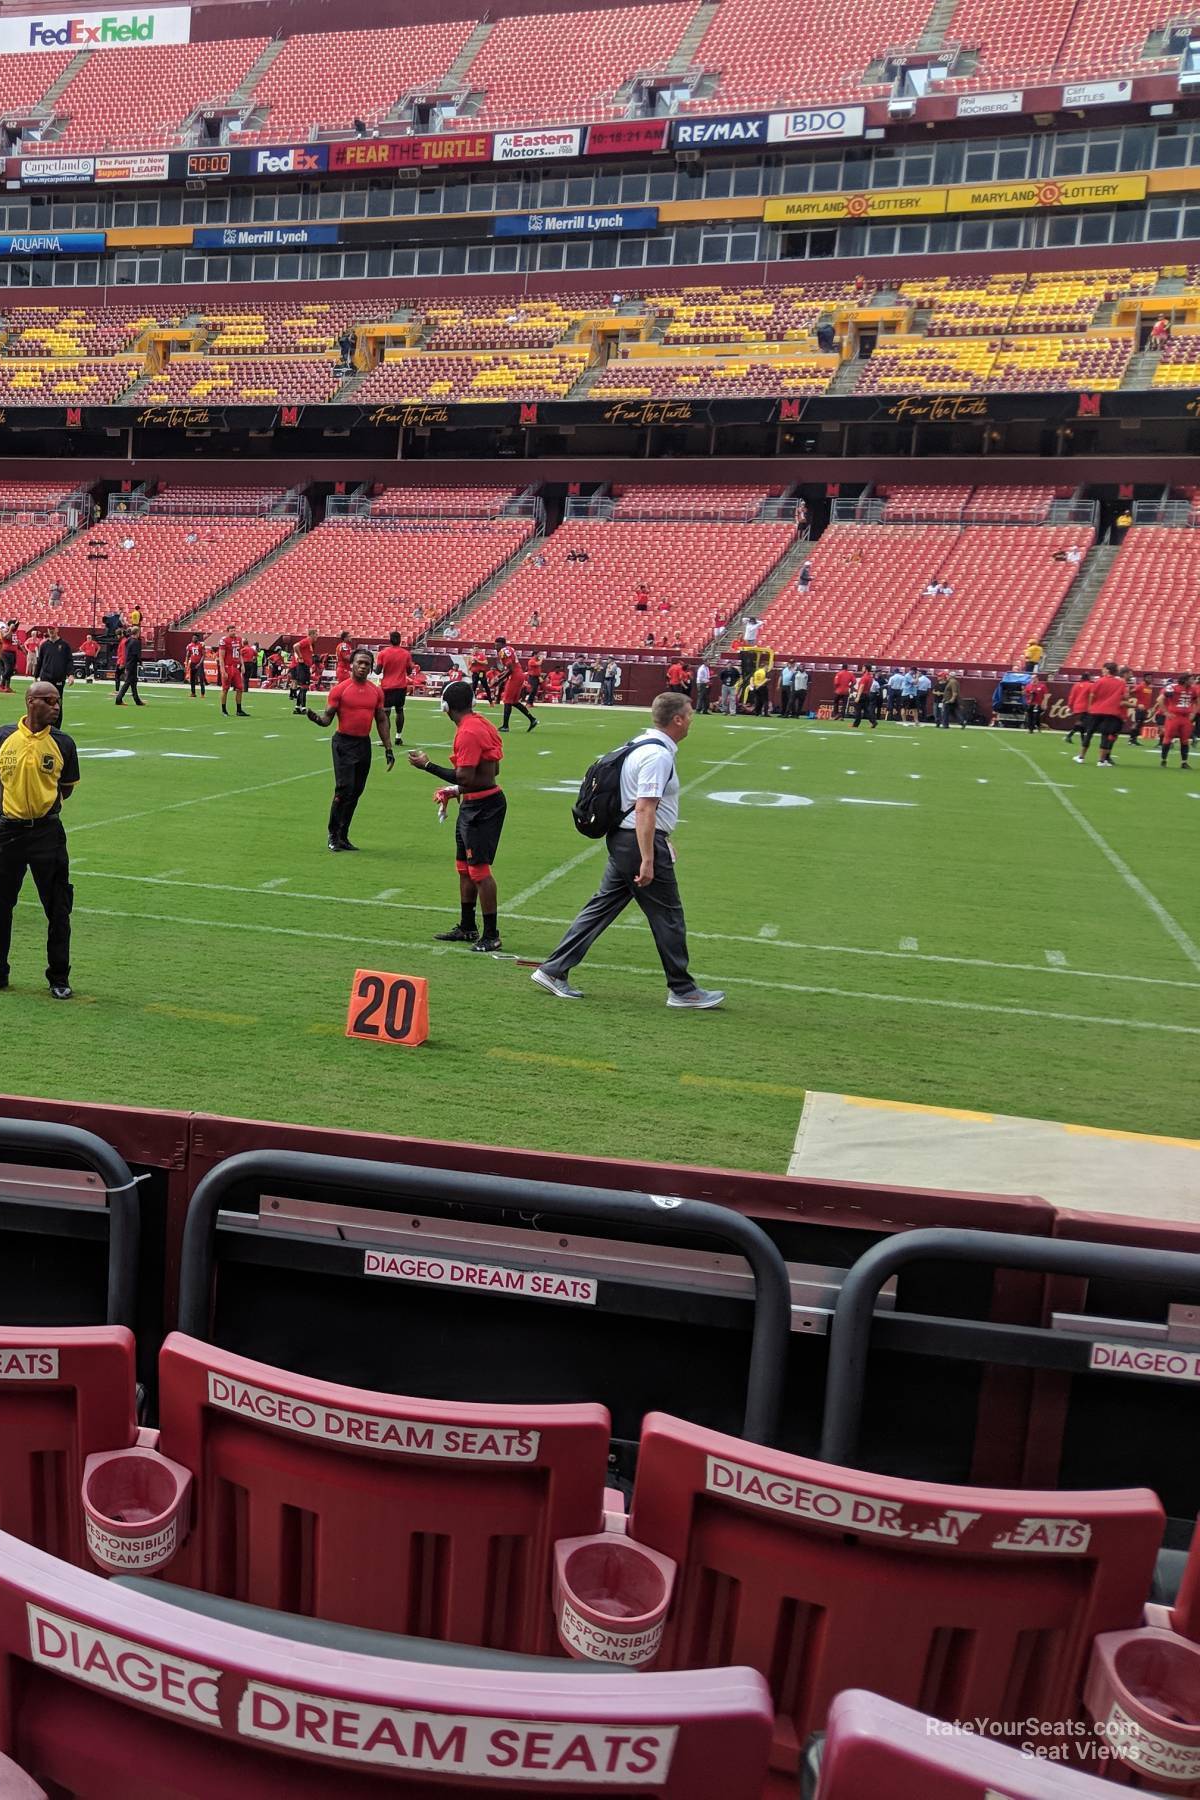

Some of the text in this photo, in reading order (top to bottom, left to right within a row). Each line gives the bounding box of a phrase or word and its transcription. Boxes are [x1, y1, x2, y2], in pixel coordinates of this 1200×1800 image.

[30, 15, 154, 46] FedExField
[678, 121, 760, 143] RE/MAX
[792, 111, 845, 132] BDO
[513, 134, 574, 148] Eastern
[24, 159, 80, 175] Carpetland
[131, 165, 165, 174] LEARN
[190, 157, 228, 172] 90:00
[257, 150, 319, 173] FedEx
[98, 168, 130, 178] Support
[971, 184, 1119, 203] MARYLAND LOTTERY
[786, 197, 921, 214] MARYLAND LOTTERY
[545, 213, 623, 231] Merrill Lynch
[10, 236, 62, 252] AQUAFINA
[238, 229, 308, 244] Merrill Lynch
[353, 976, 416, 1039] 20
[366, 1253, 592, 1301] DIAGEO DREAM SEATS
[1094, 1347, 1187, 1375] DIAGEO
[213, 1377, 534, 1458] DIAGEO DREAM SEATS
[713, 1463, 842, 1519] DIAGEO
[851, 1502, 974, 1542] DRAM
[105, 1549, 140, 1564] TEAM
[564, 1620, 626, 1661] IS A TEAM
[251, 1691, 469, 1765] DREAM
[486, 1727, 664, 1776] SEATS
[1139, 1751, 1186, 1776] TEAM
